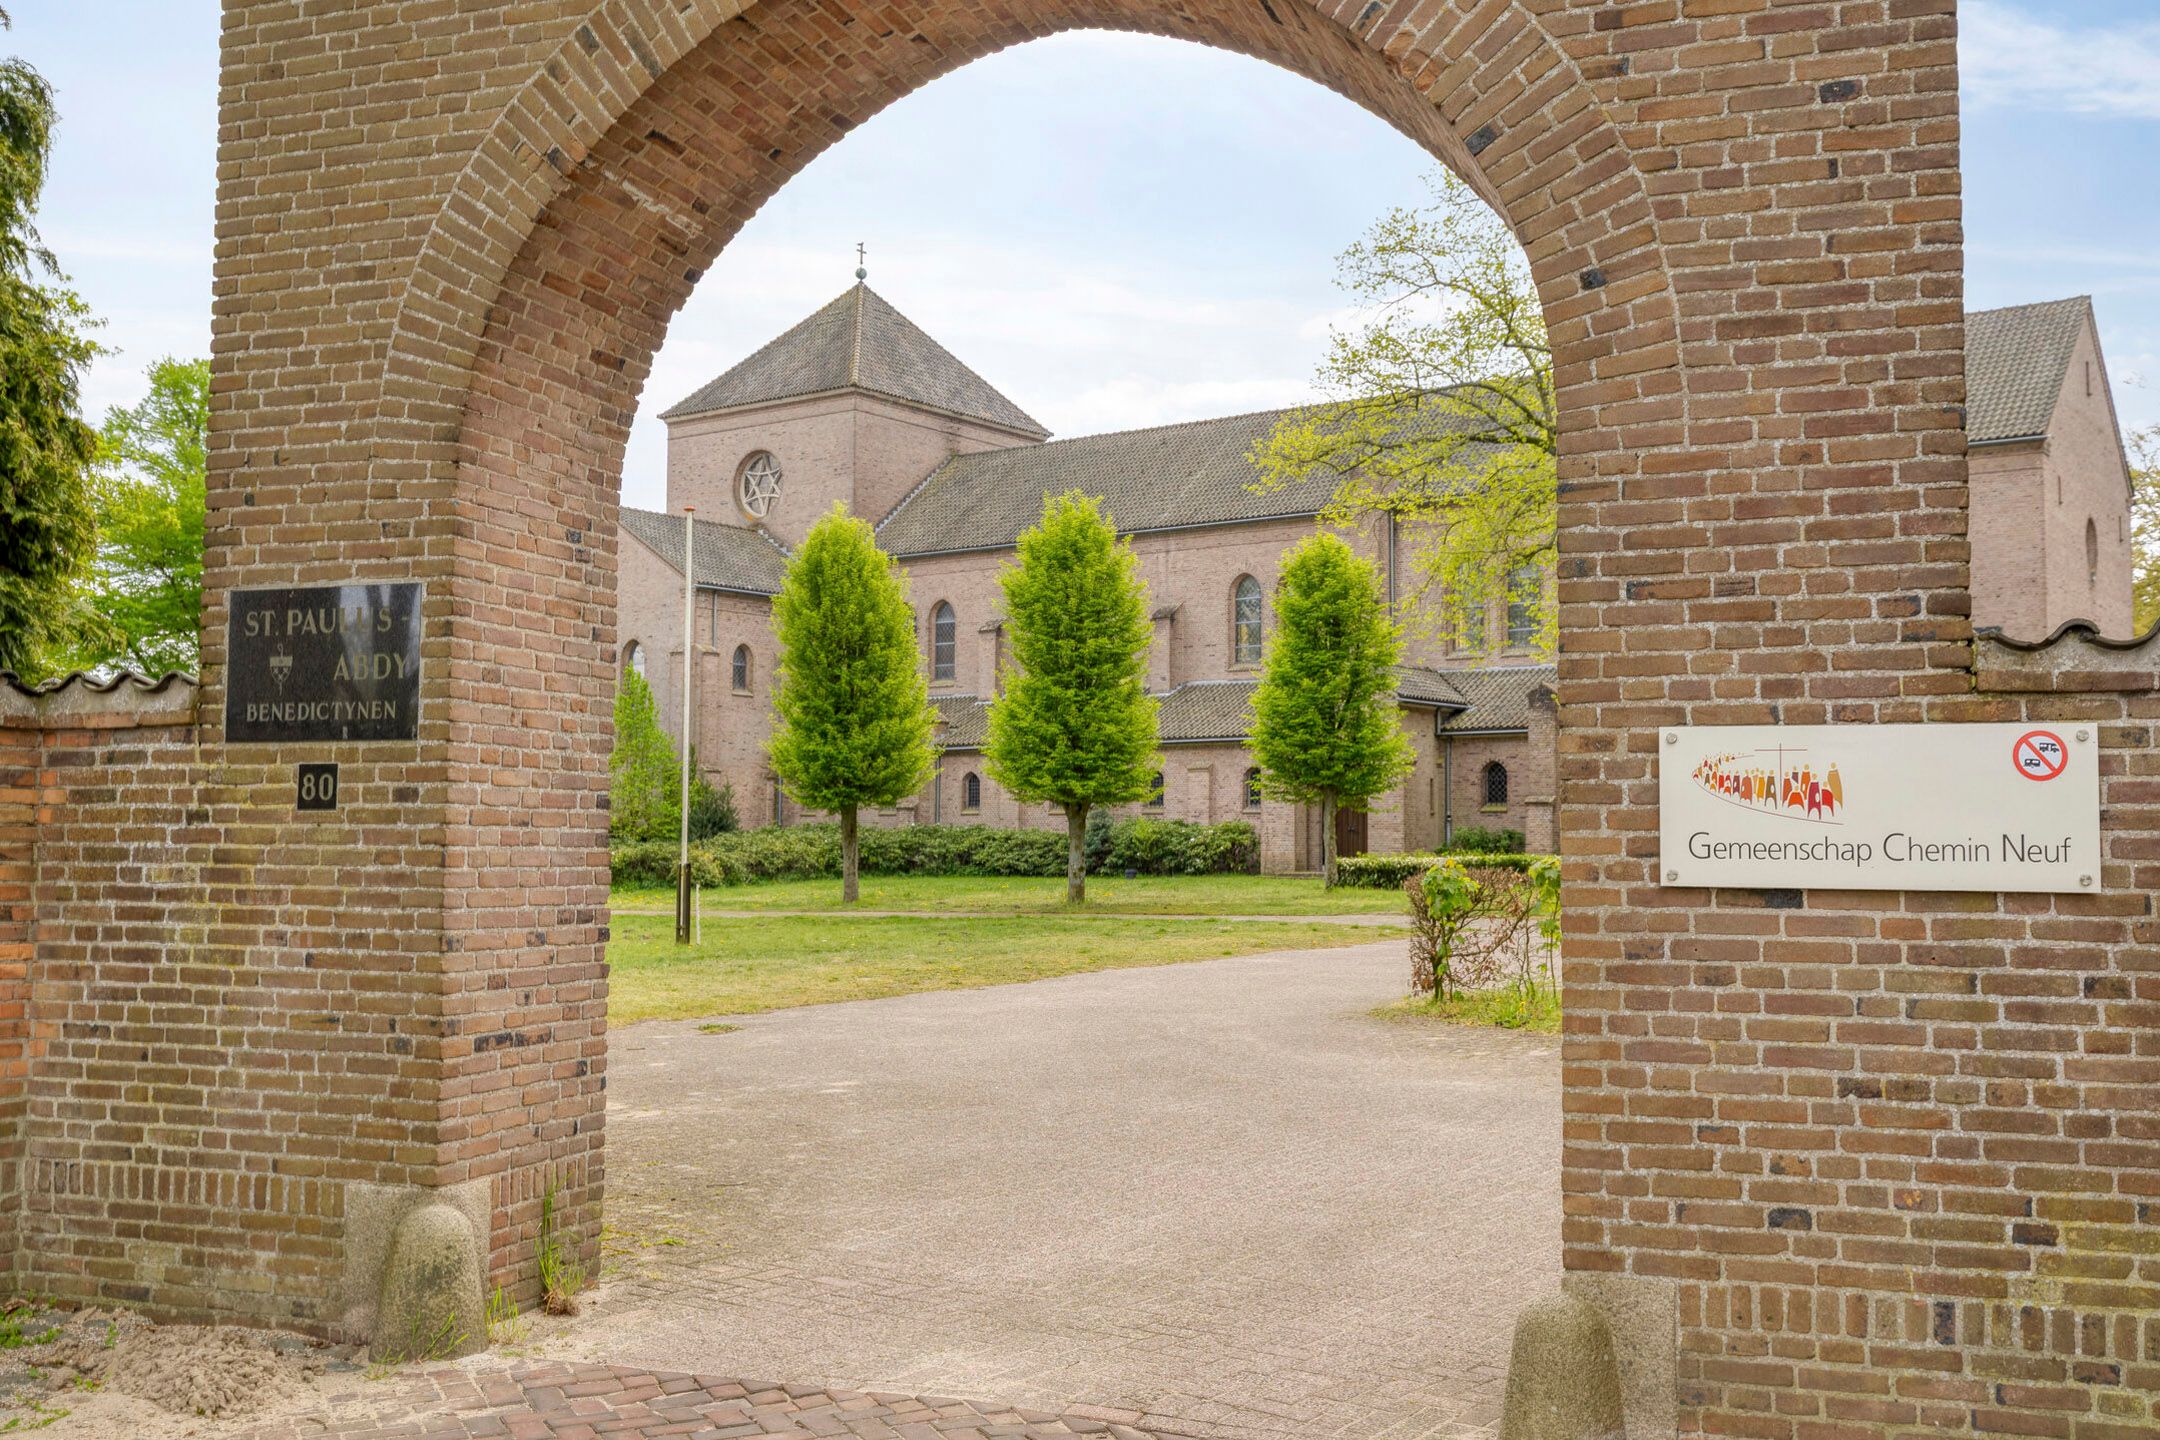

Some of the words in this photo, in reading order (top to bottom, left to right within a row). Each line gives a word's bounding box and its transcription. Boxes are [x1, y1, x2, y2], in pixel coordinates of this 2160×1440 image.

[244, 610, 279, 637] ST.
[333, 652, 407, 680] ABDY
[246, 701, 396, 722] BENEDICTYNEN
[301, 774, 334, 800] 80
[1688, 831, 1872, 867] Gemeenschap
[1883, 832, 1990, 862] Chemin
[2002, 833, 2071, 864] Neuf
